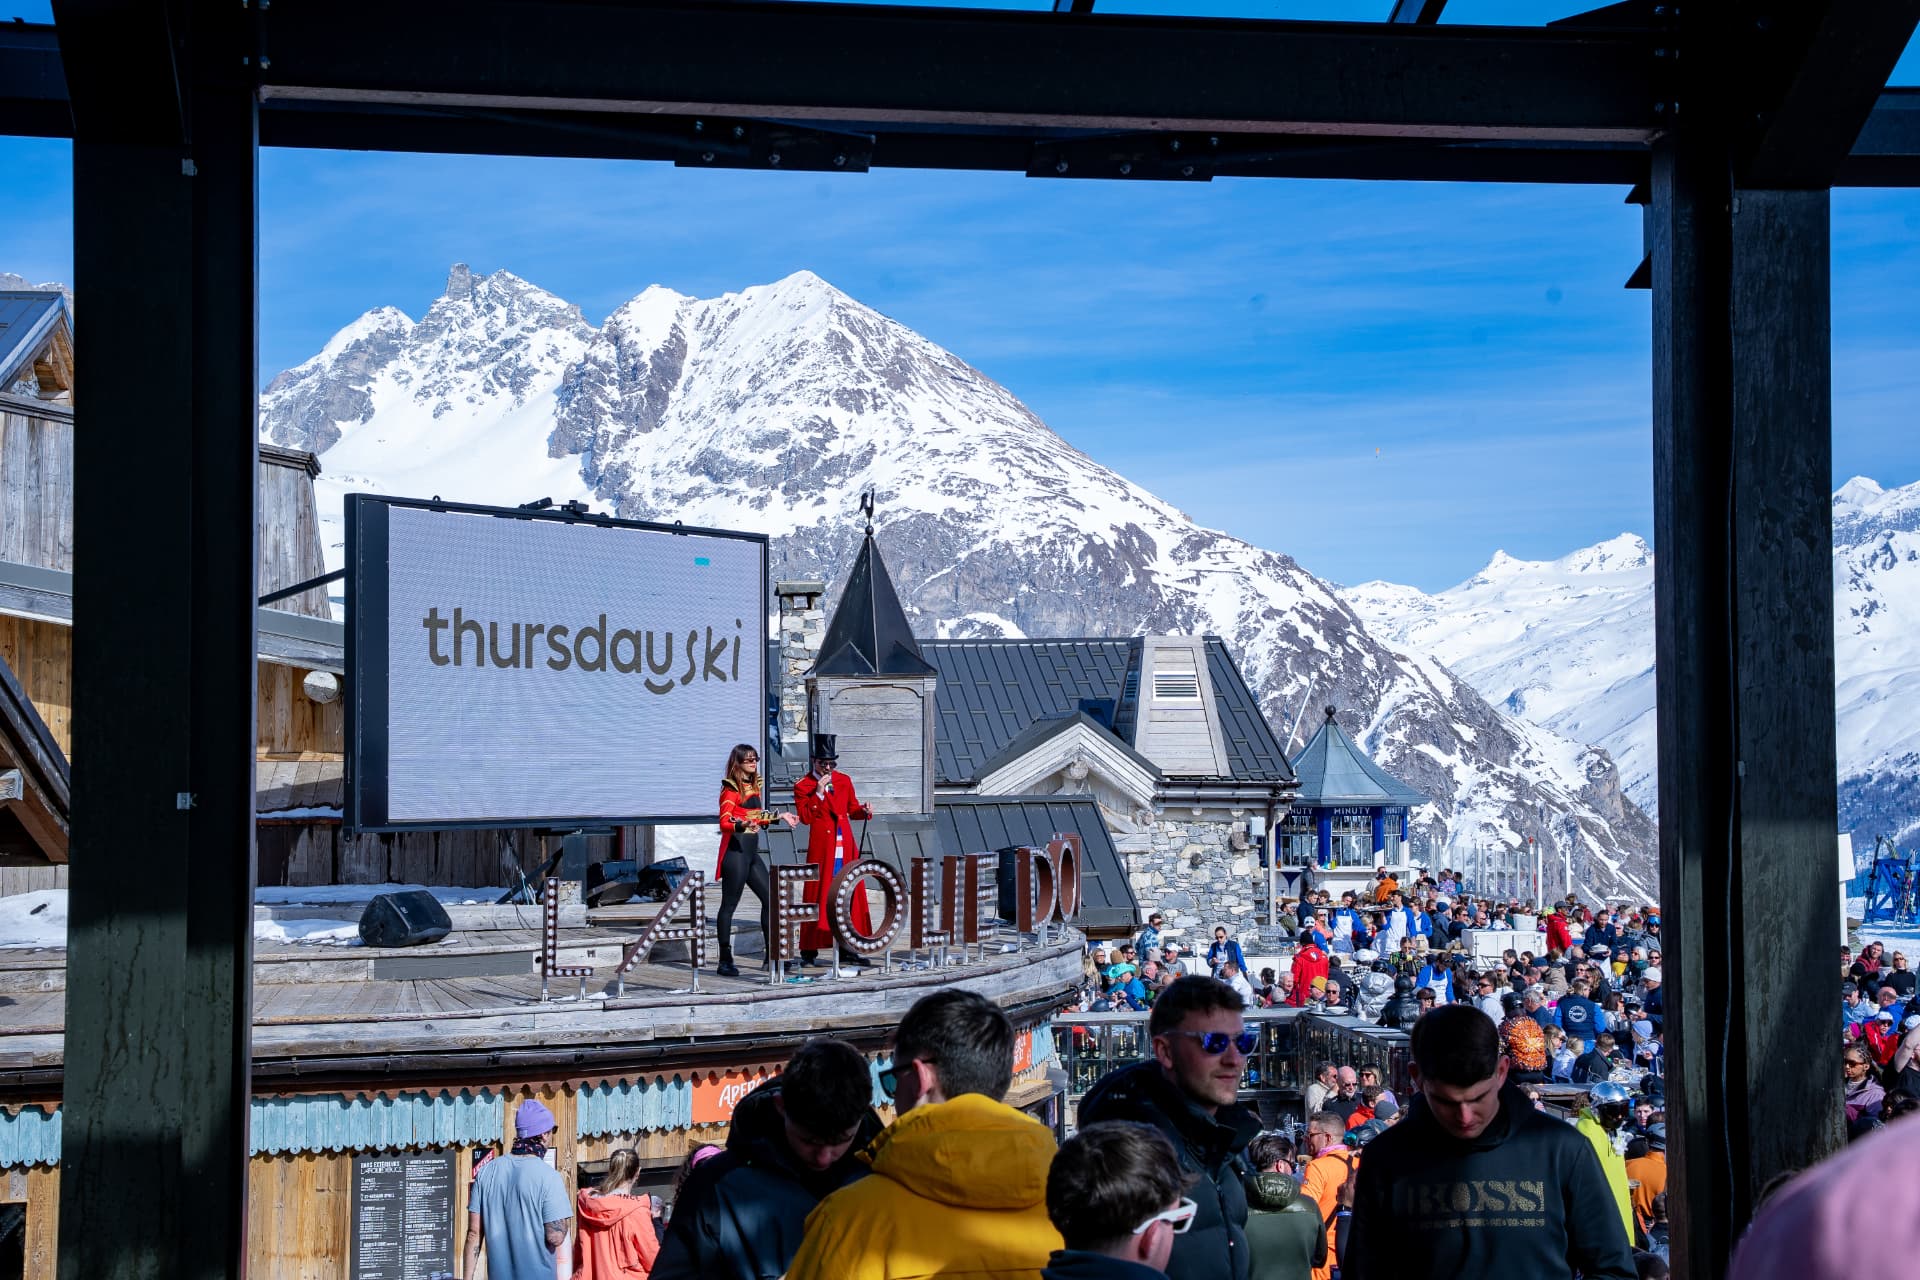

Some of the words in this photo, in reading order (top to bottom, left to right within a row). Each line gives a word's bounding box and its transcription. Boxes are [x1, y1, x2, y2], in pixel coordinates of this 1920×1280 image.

[1333, 807, 1370, 815] MINUTY
[542, 869, 706, 978] LA
[769, 851, 1000, 963] FOLIE
